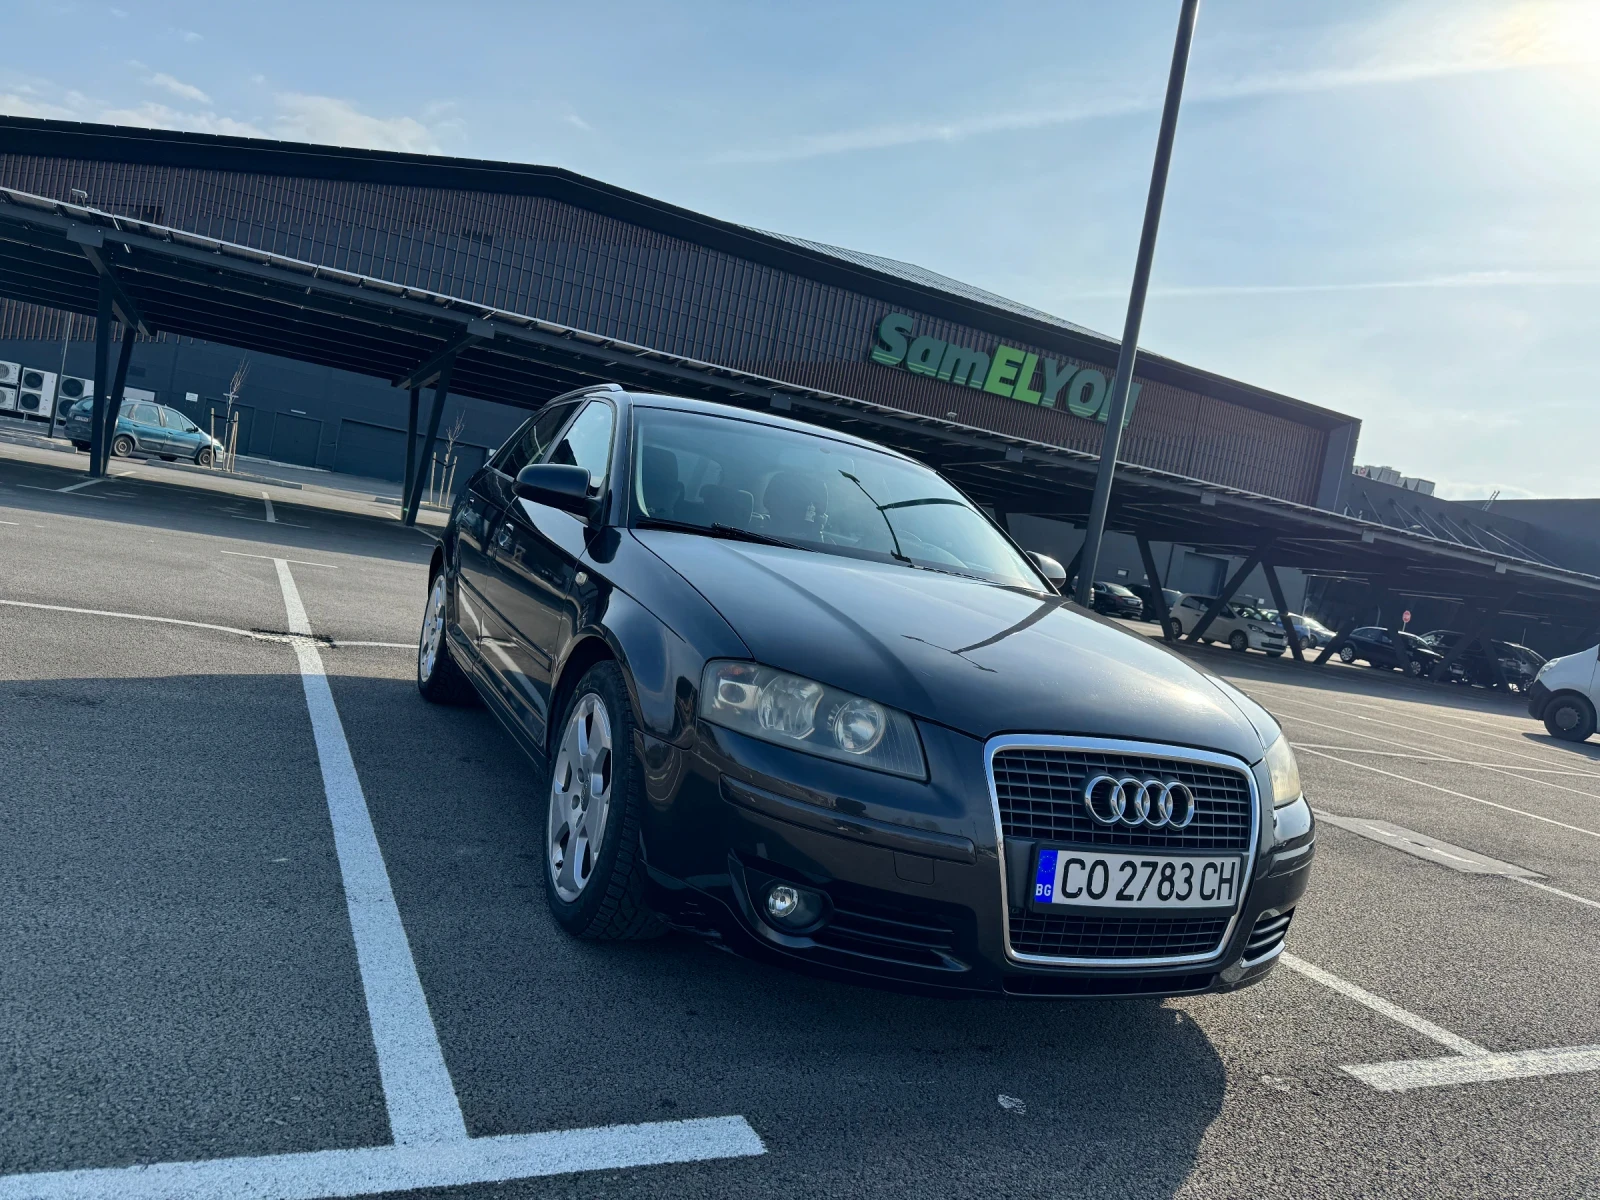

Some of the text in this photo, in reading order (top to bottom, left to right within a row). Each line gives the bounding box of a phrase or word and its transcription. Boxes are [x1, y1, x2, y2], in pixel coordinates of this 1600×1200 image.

[1035, 883, 1052, 897] BG
[1061, 857, 1236, 902] CO 2783 CH
